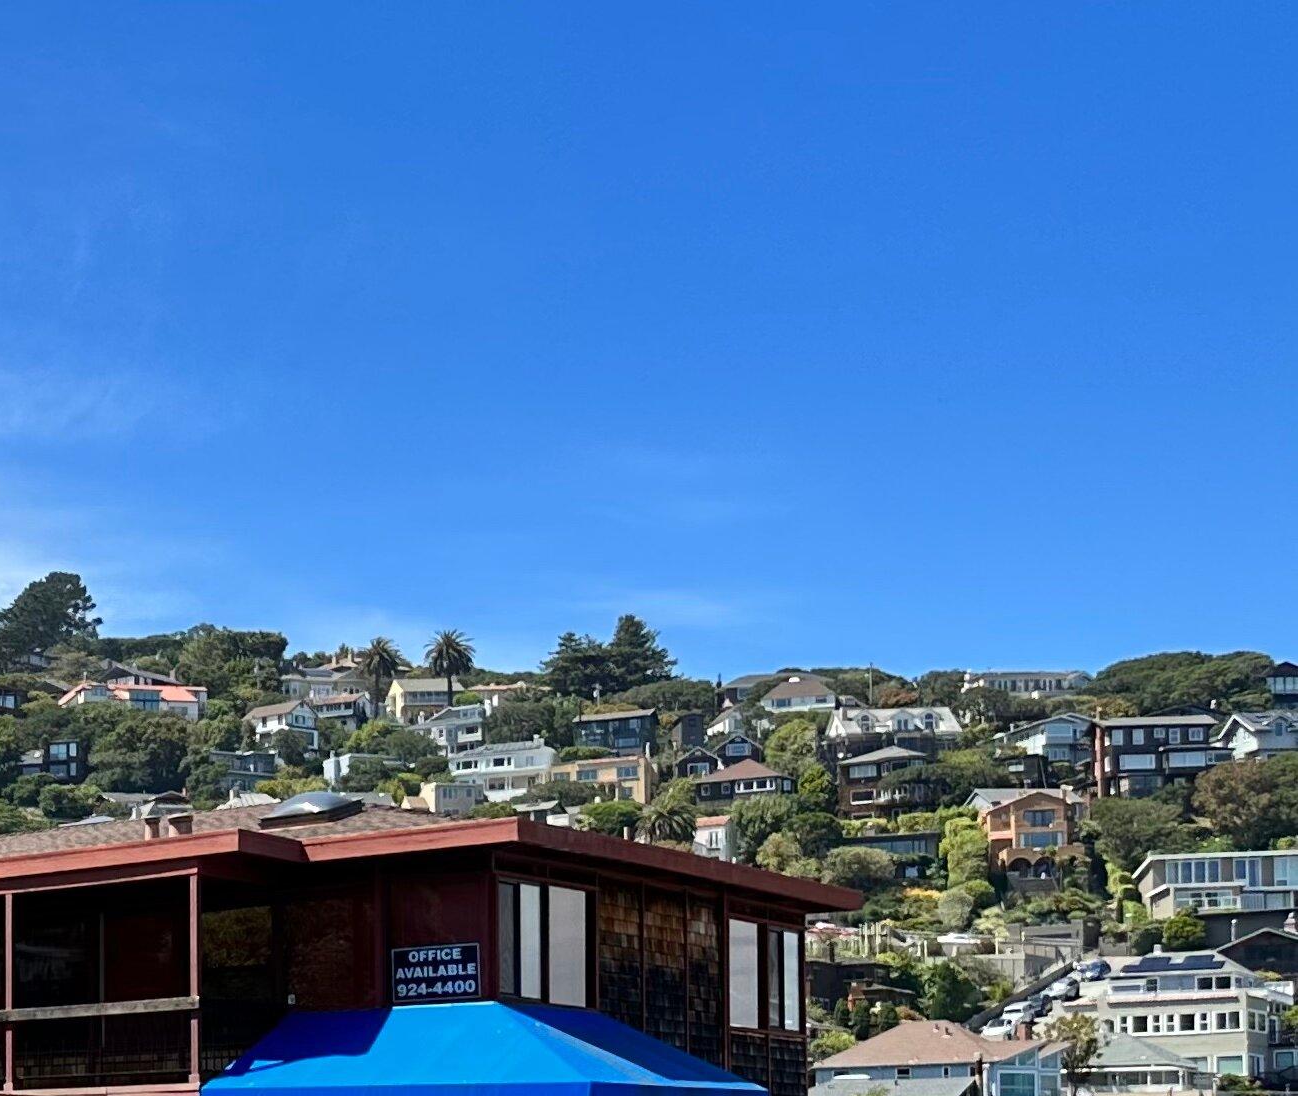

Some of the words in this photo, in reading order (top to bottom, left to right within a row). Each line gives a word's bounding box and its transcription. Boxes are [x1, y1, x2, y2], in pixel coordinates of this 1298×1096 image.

[408, 948, 463, 962] OFFICE
[396, 963, 477, 979] AVAILABLE
[397, 980, 476, 997] 924-4400
